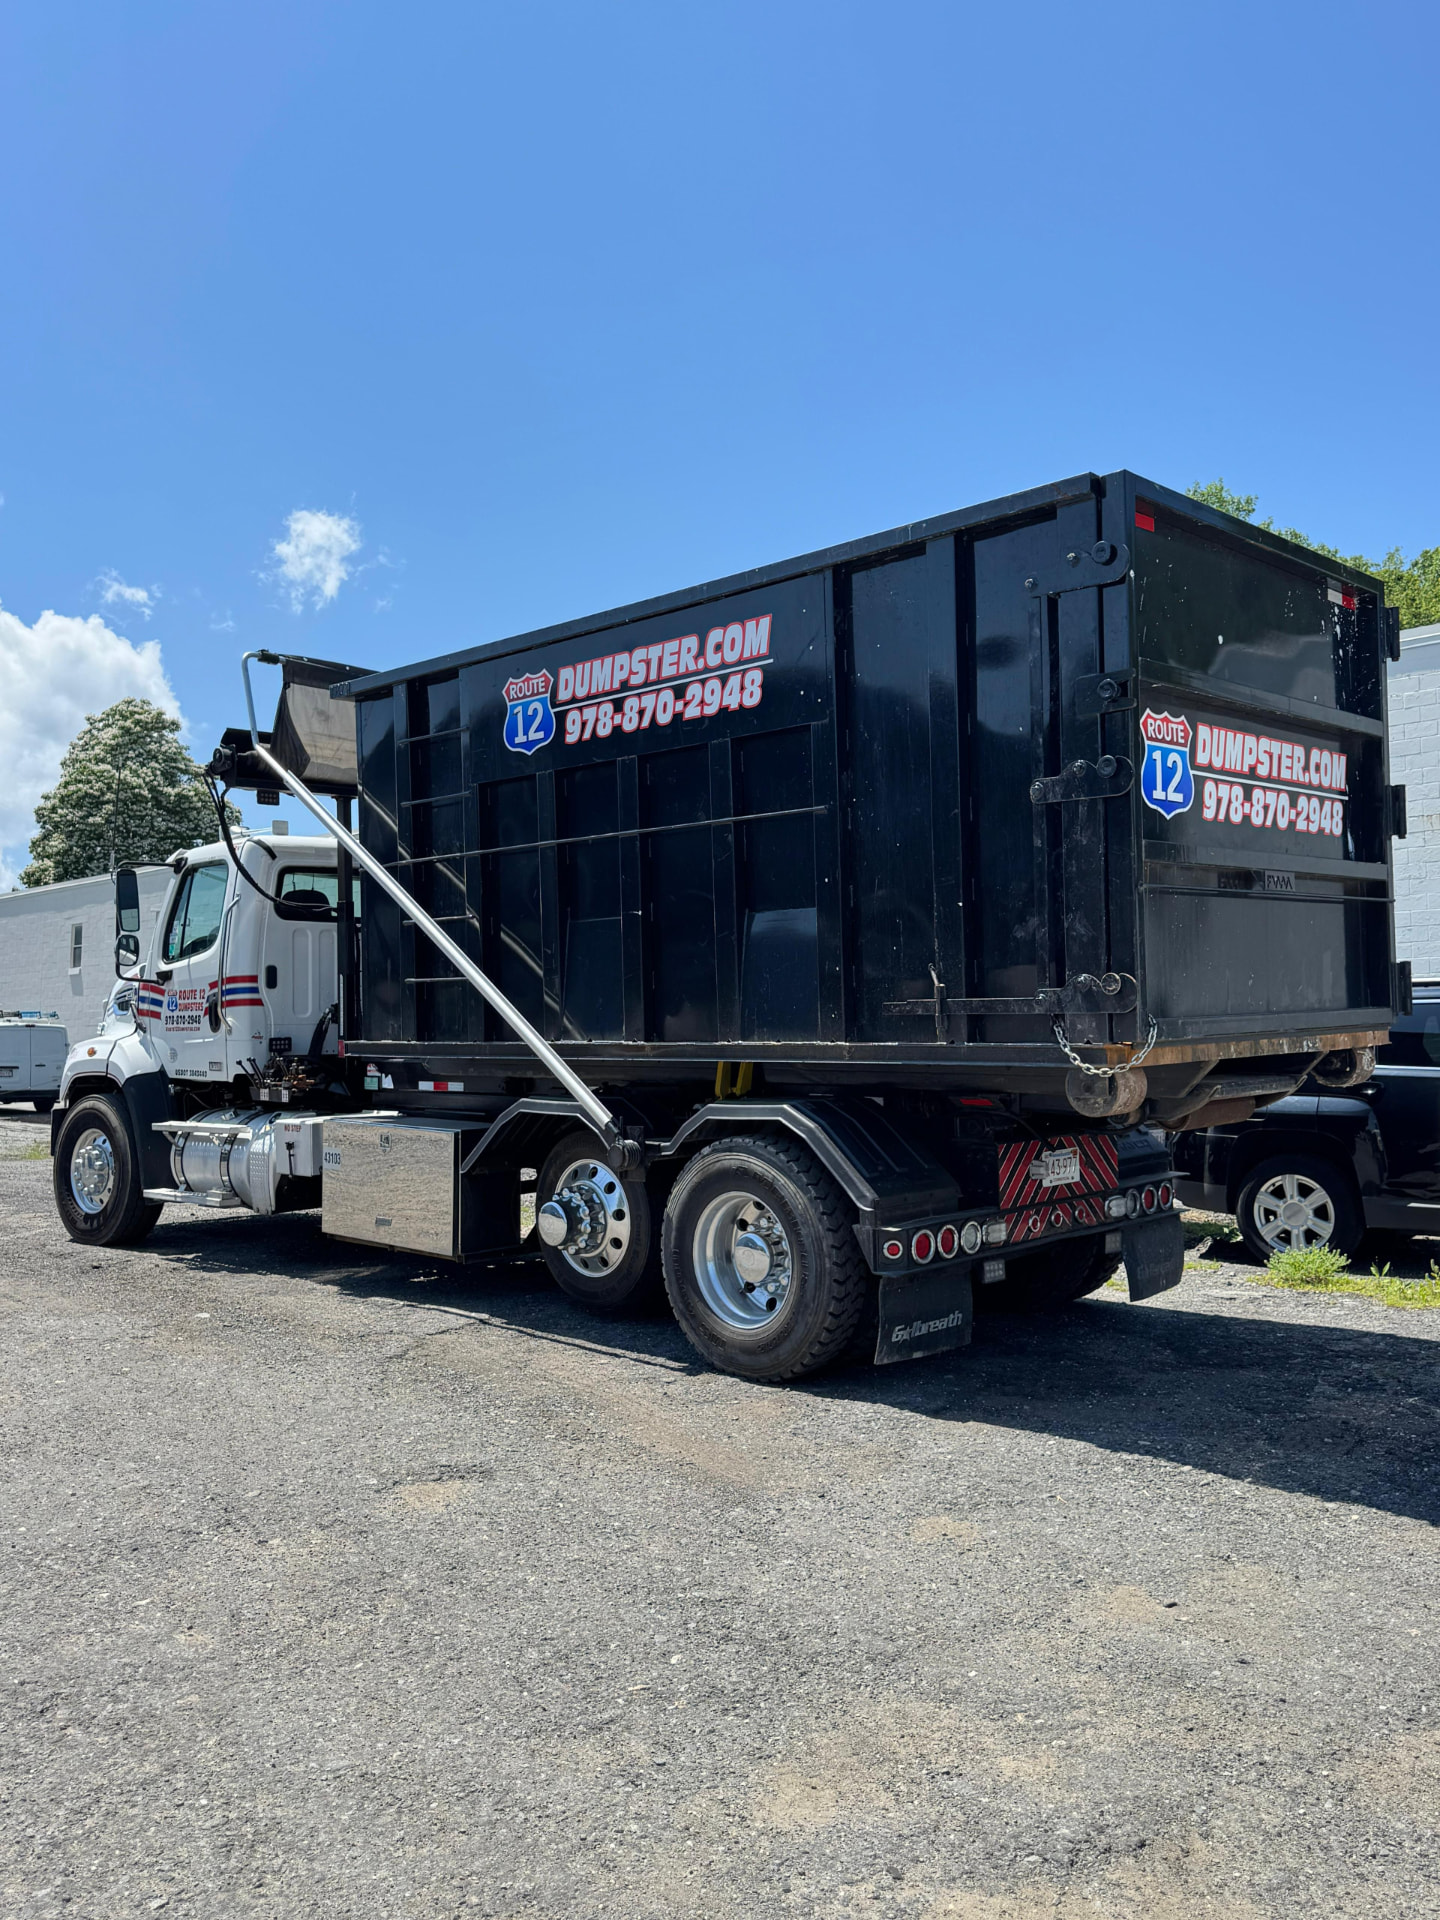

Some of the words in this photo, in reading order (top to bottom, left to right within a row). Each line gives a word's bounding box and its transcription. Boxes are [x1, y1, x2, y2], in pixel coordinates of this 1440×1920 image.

[556, 613, 773, 704] DUMPSTER.COM
[509, 677, 546, 700] ROUTE
[513, 701, 545, 744] 12
[565, 667, 763, 745] 978-870-2948
[1147, 718, 1185, 744] ROUTE
[1194, 722, 1347, 792] DUMPSTER.COM
[1152, 750, 1184, 803] 12
[1202, 778, 1343, 837] 978-870-2948
[169, 997, 176, 1010] 12
[178, 989, 197, 1001] ROUTE
[199, 988, 205, 1000] 12
[165, 1015, 201, 1025] 978-870-2948
[324, 1151, 341, 1165] 43103
